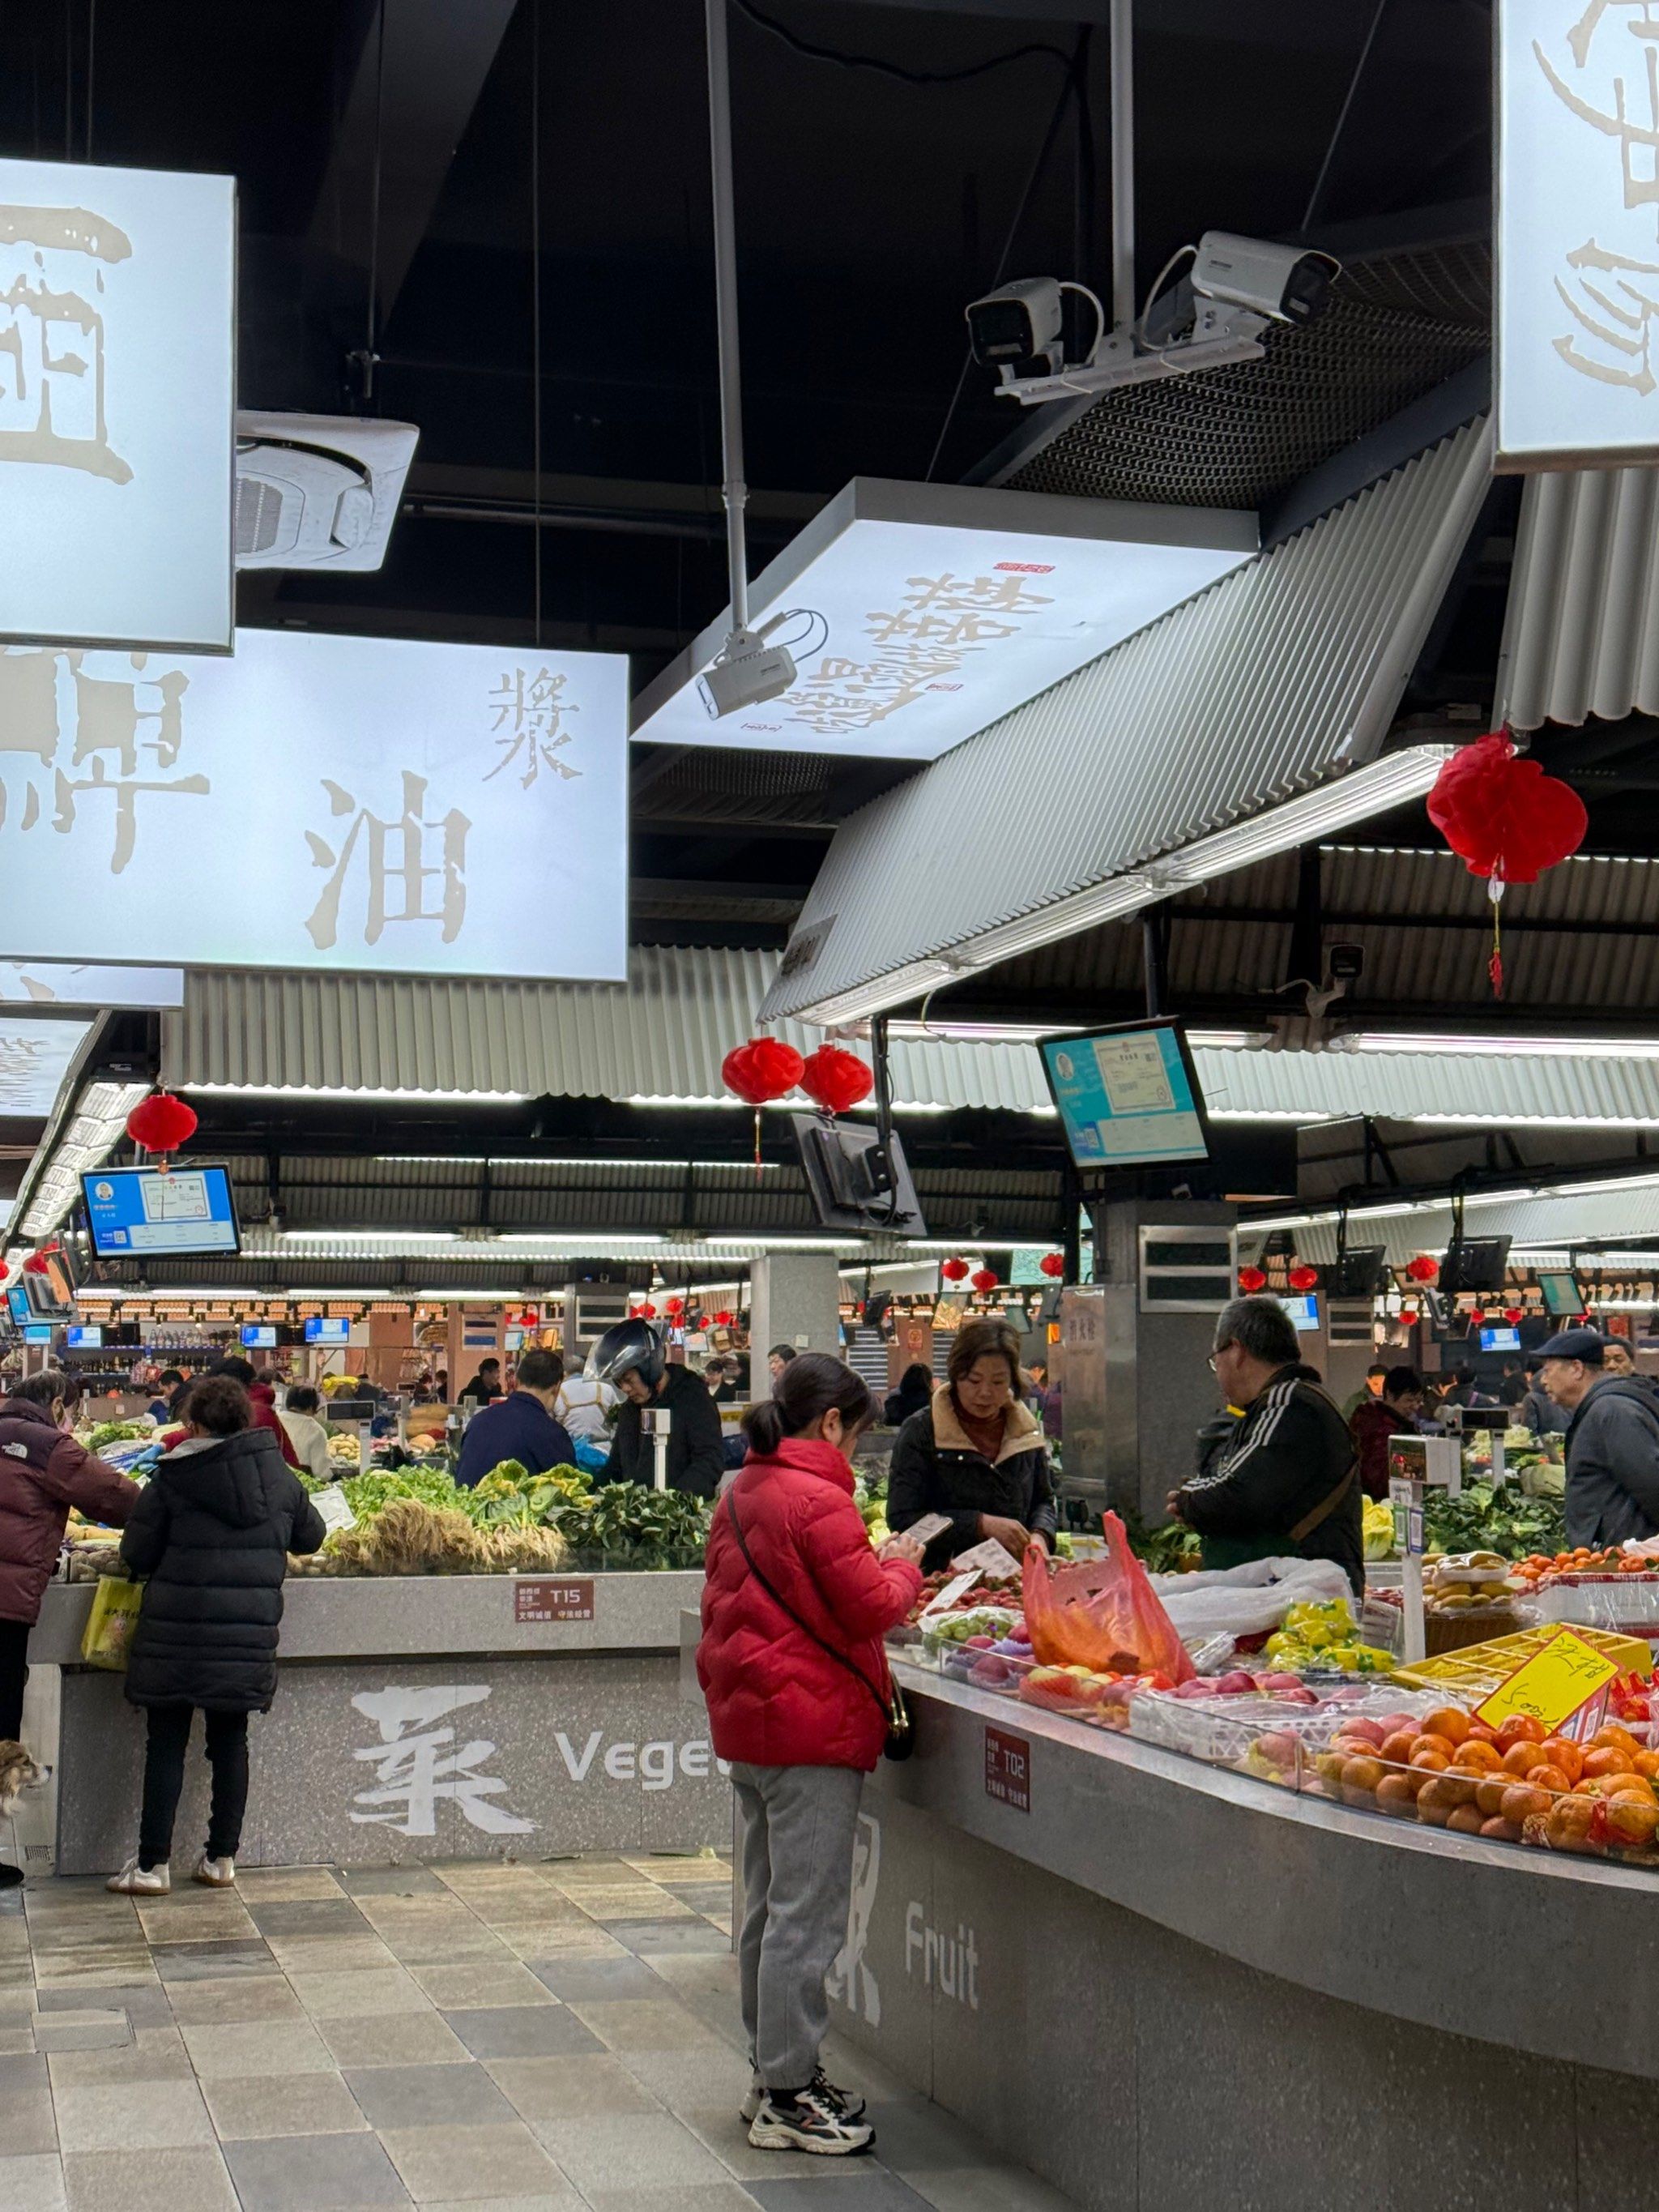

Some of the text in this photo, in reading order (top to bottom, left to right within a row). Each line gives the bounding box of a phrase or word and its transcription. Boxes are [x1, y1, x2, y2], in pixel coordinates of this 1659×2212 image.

[303, 770, 473, 950] 油
[550, 1588, 581, 1603] T15
[1003, 1749, 1025, 1780] T02
[906, 1901, 979, 2010] Fruit
